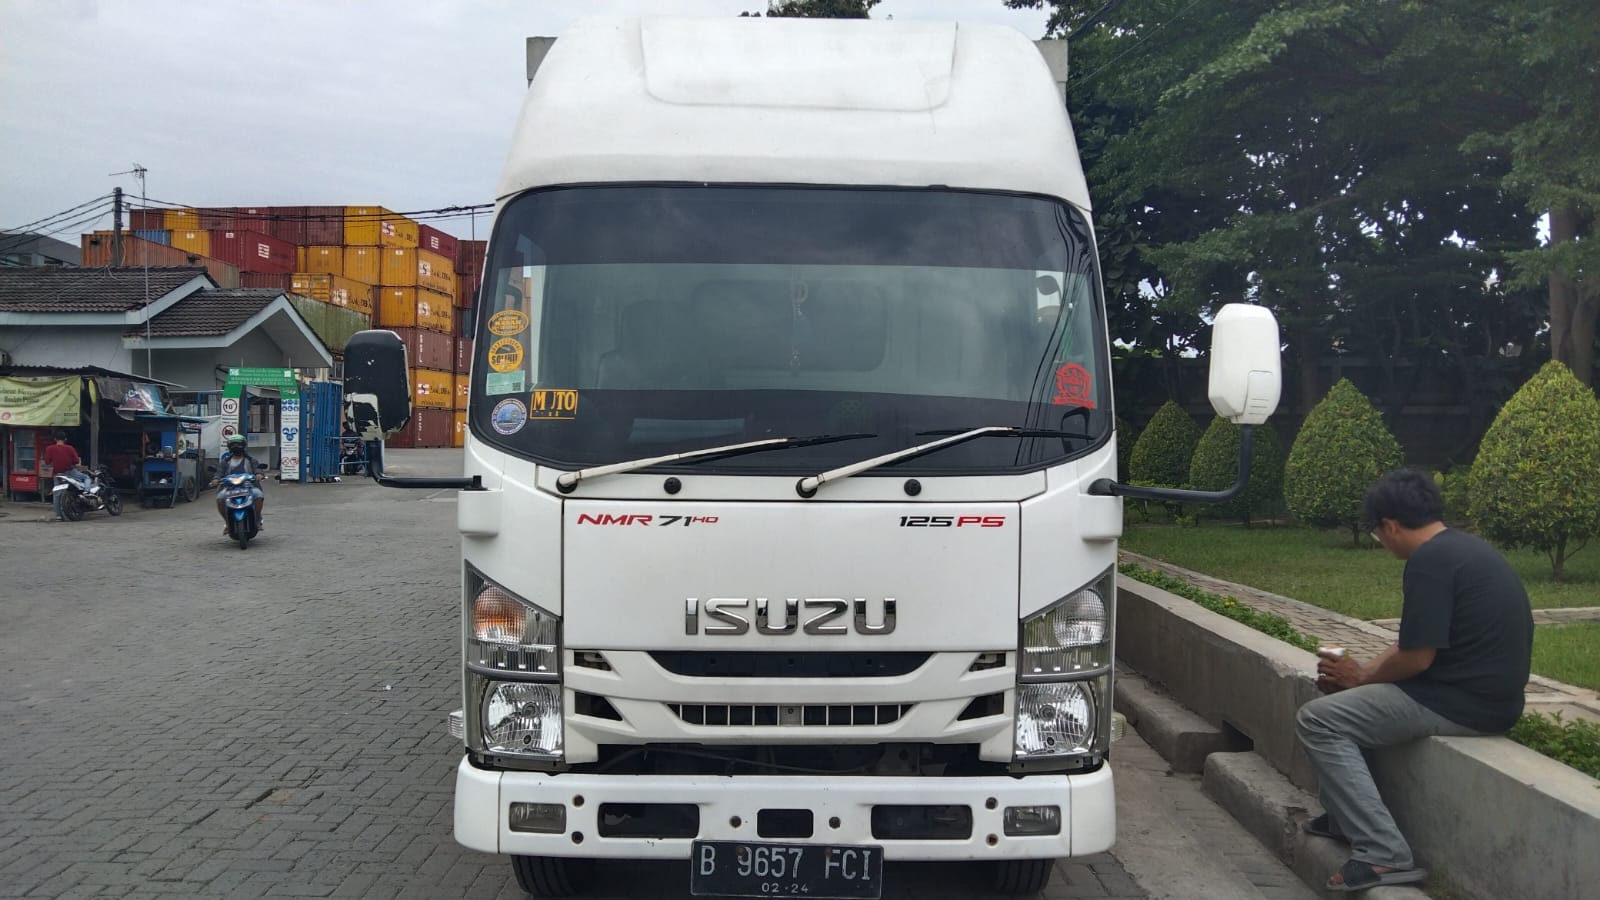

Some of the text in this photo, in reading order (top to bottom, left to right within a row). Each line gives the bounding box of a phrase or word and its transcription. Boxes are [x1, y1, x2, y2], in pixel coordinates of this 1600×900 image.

[577, 514, 653, 526] NMR
[685, 597, 896, 635] ISUZU
[700, 845, 872, 880] B 9657 FCI
